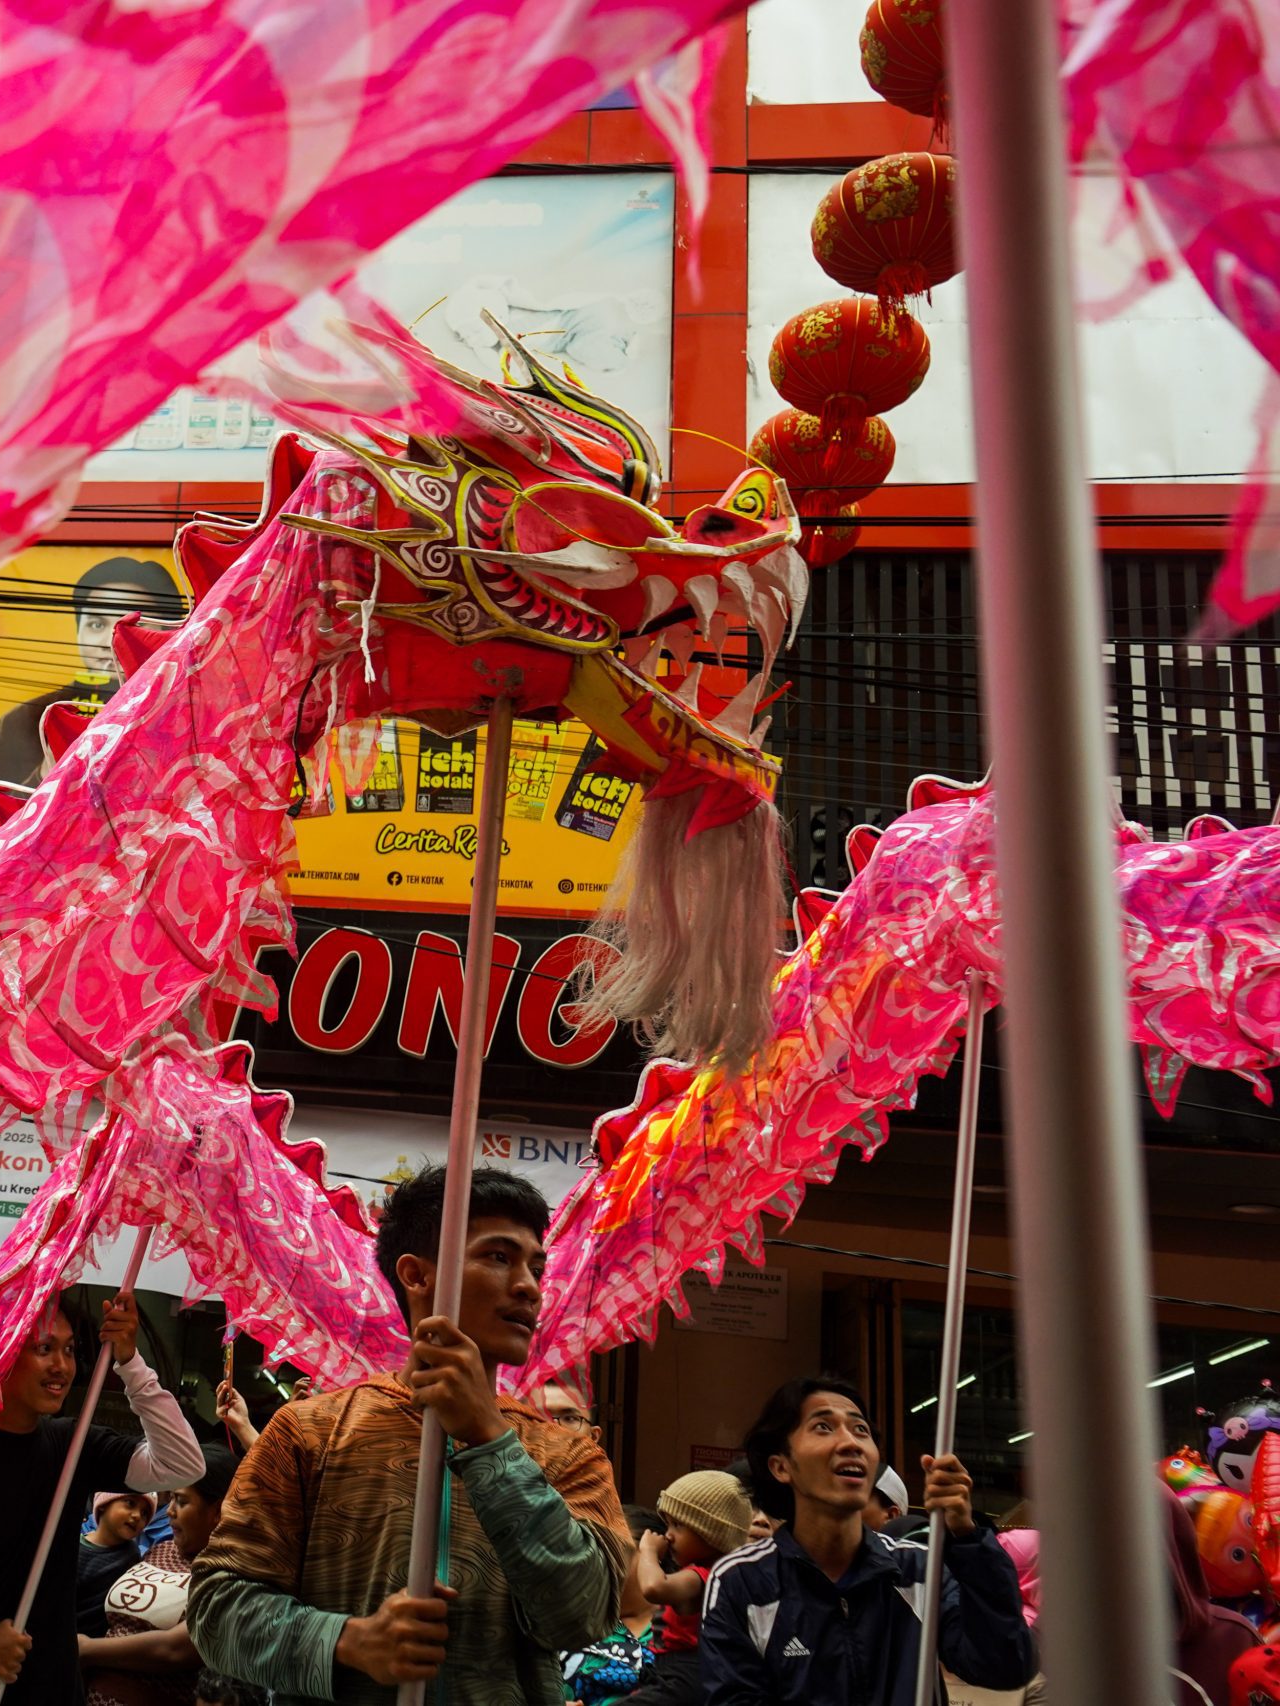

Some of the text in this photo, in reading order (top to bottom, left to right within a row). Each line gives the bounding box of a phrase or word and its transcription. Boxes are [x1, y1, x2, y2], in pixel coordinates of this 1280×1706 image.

[421, 742, 474, 772] teh
[420, 771, 472, 789] kotak
[571, 790, 622, 819] kotak
[375, 823, 451, 854] Cerita
[287, 870, 360, 881] WWW.TEHKOTAK.COM
[406, 875, 444, 885] TEH KOTAK
[4, 1132, 34, 1144] 2025
[517, 1135, 585, 1166] BNI
[10, 1183, 40, 1196] Kred
[783, 1649, 811, 1657] adidas
